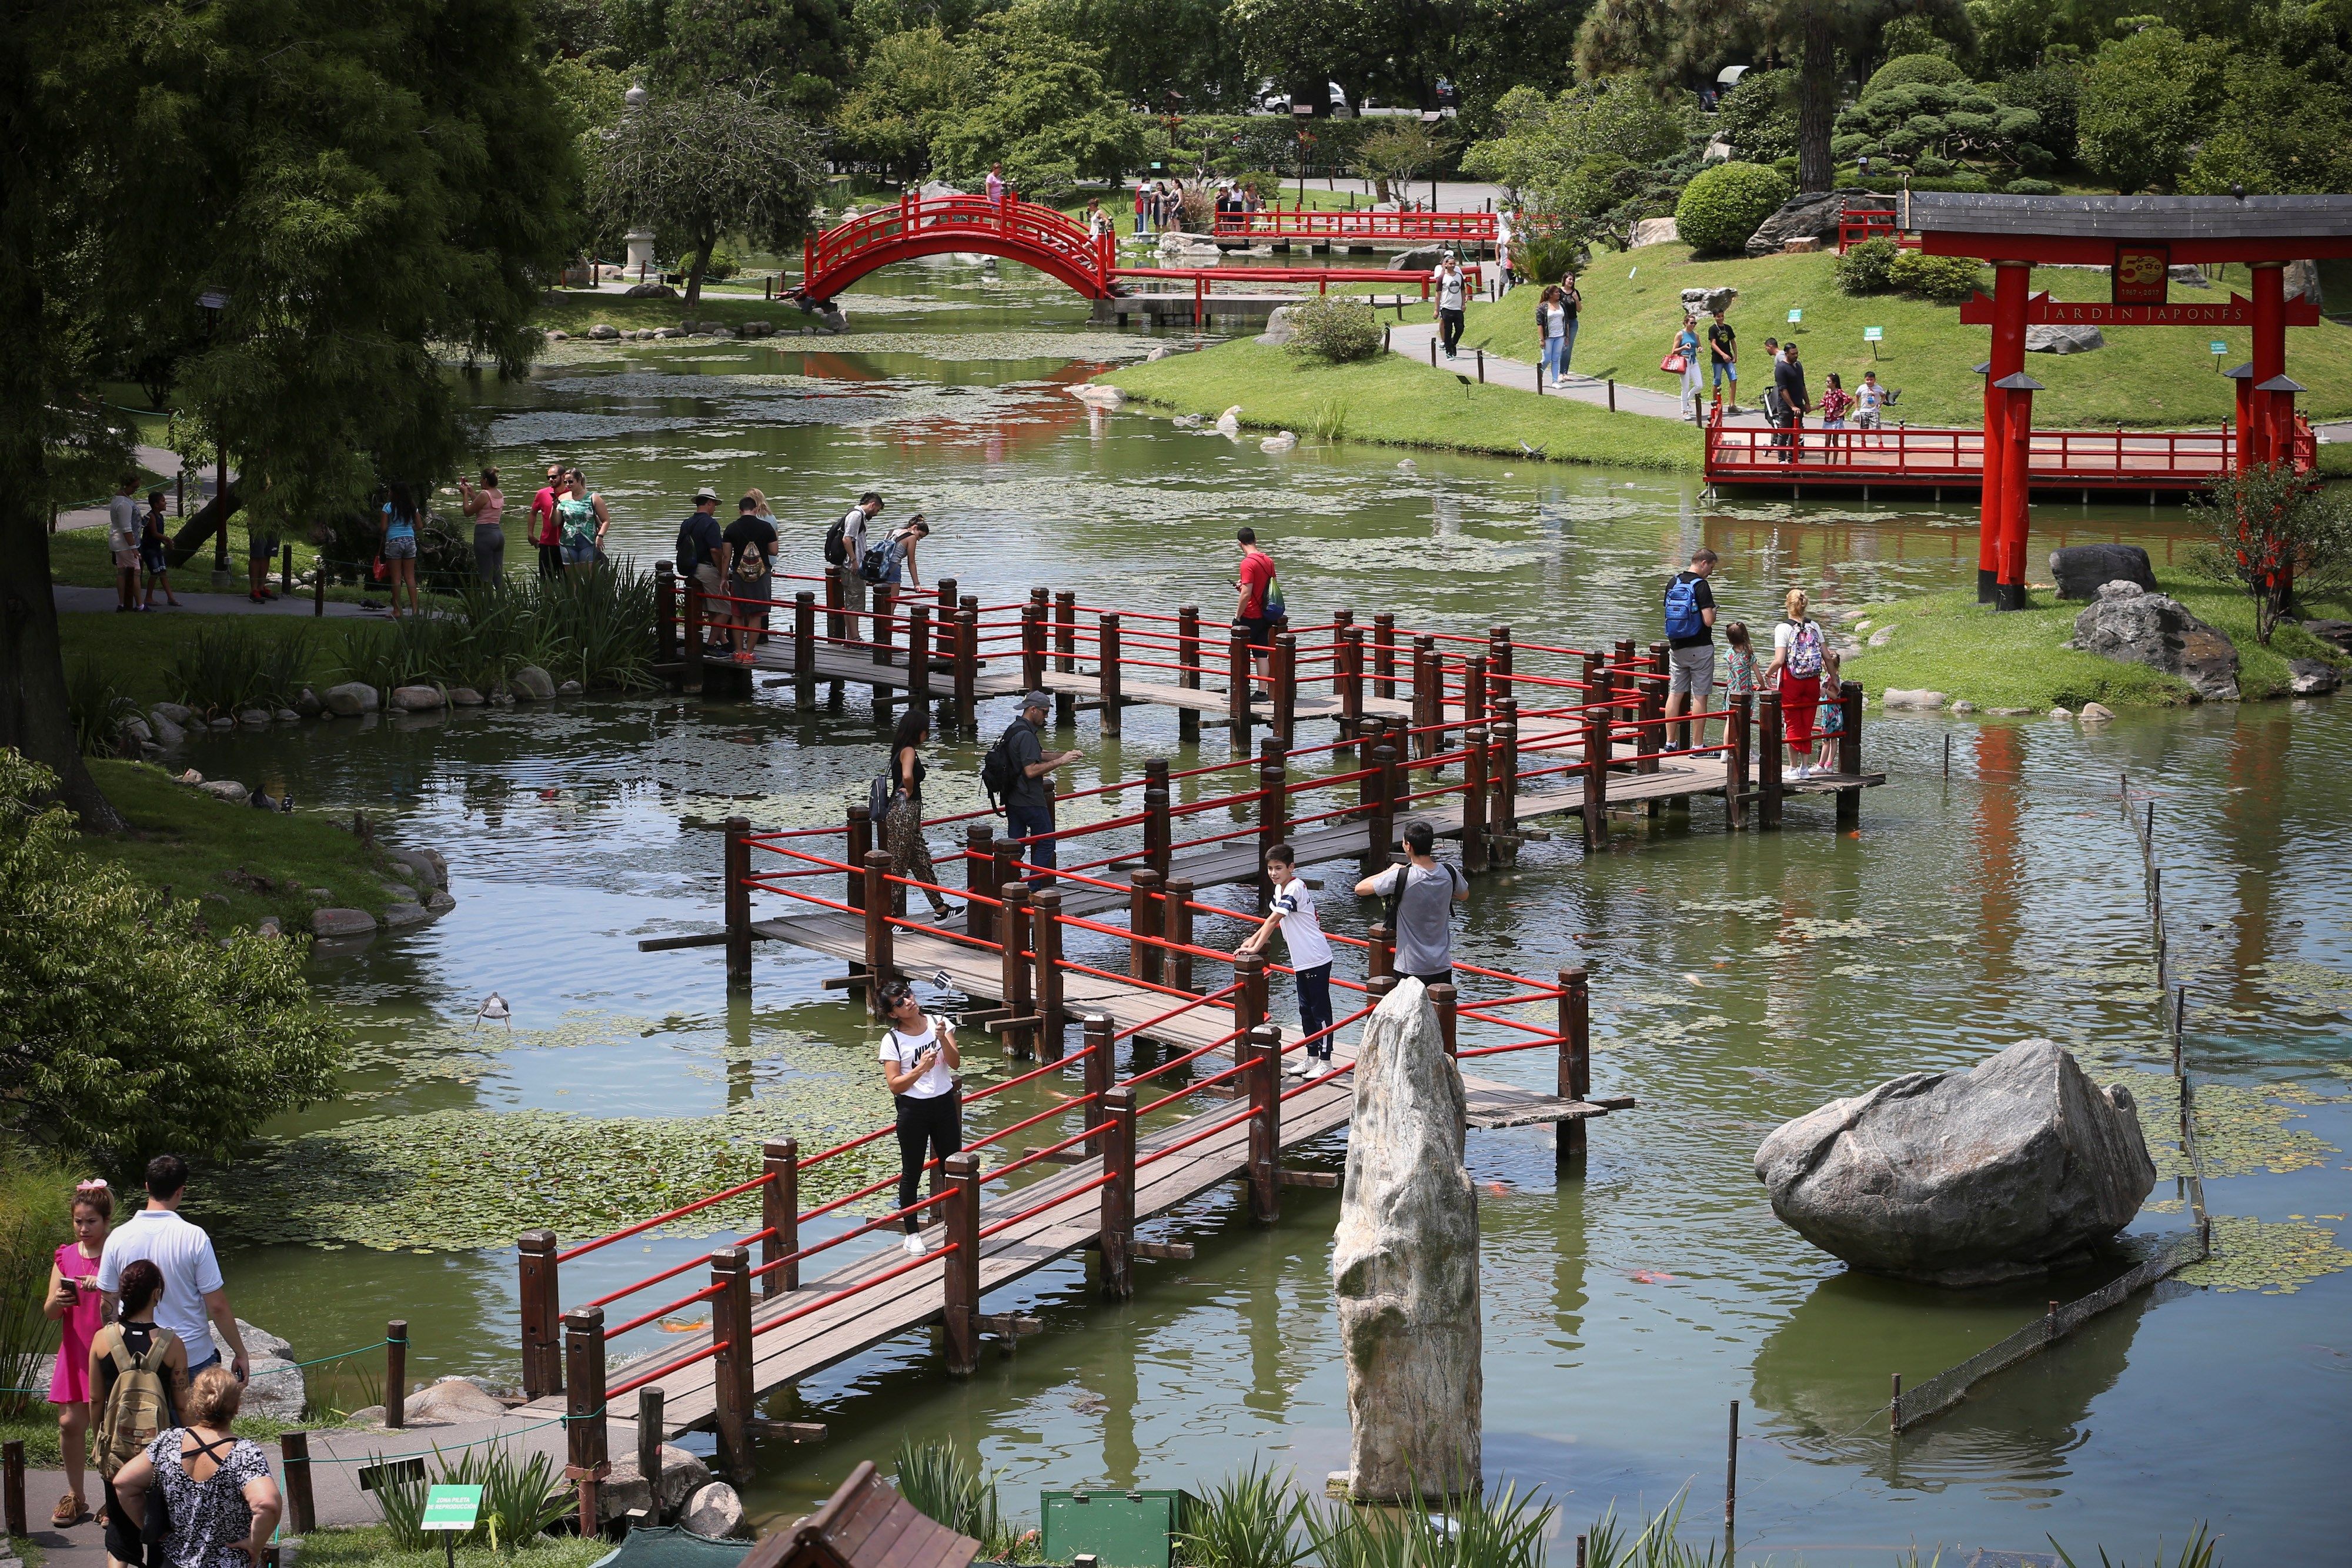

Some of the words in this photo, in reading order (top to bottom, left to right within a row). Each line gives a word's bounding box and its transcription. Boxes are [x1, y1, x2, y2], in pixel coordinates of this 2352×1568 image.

[2119, 255, 2163, 285] 50
[2044, 305, 2132, 319] JARDÍN
[2147, 305, 2241, 321] JAPONÉS
